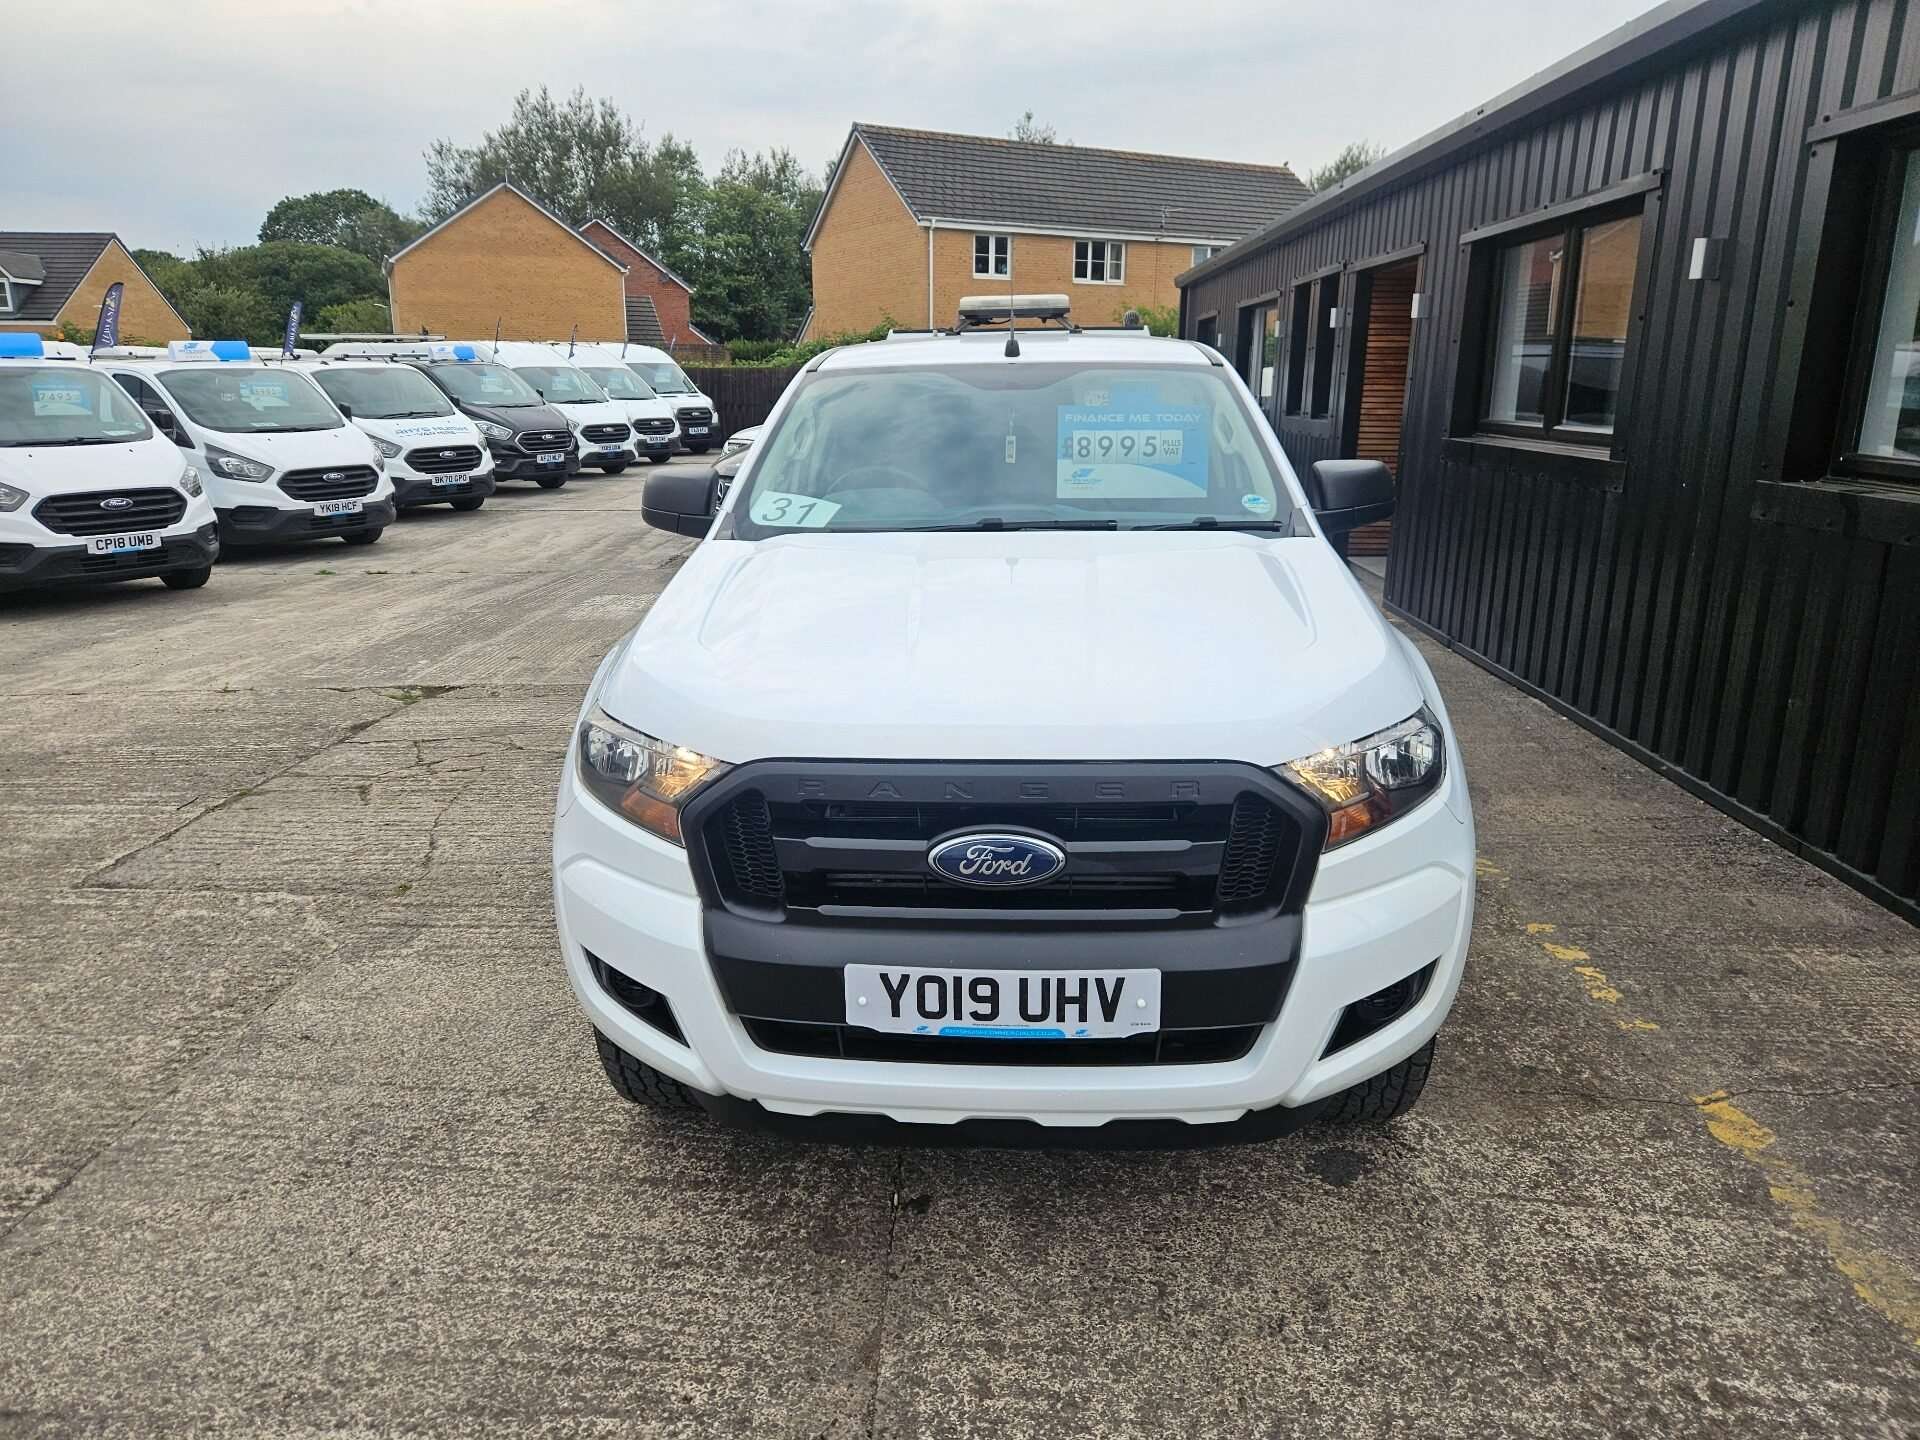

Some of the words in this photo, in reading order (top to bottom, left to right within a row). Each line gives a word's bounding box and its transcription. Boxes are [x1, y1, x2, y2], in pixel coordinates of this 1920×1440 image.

[1064, 413, 1125, 424] FINANCE
[1128, 413, 1152, 423] ME
[1156, 413, 1202, 424] TODAY
[1162, 439, 1181, 447] PLUS
[1163, 448, 1179, 456] VAT
[320, 503, 340, 513] YK18
[341, 501, 357, 511] HCF
[761, 497, 818, 525] 31
[95, 537, 126, 551] CP18
[128, 534, 154, 547] UMB
[799, 778, 1201, 799] RANGER
[959, 844, 1033, 876] Ford
[878, 972, 1000, 1022] YO19
[1018, 976, 1126, 1023] UHV
